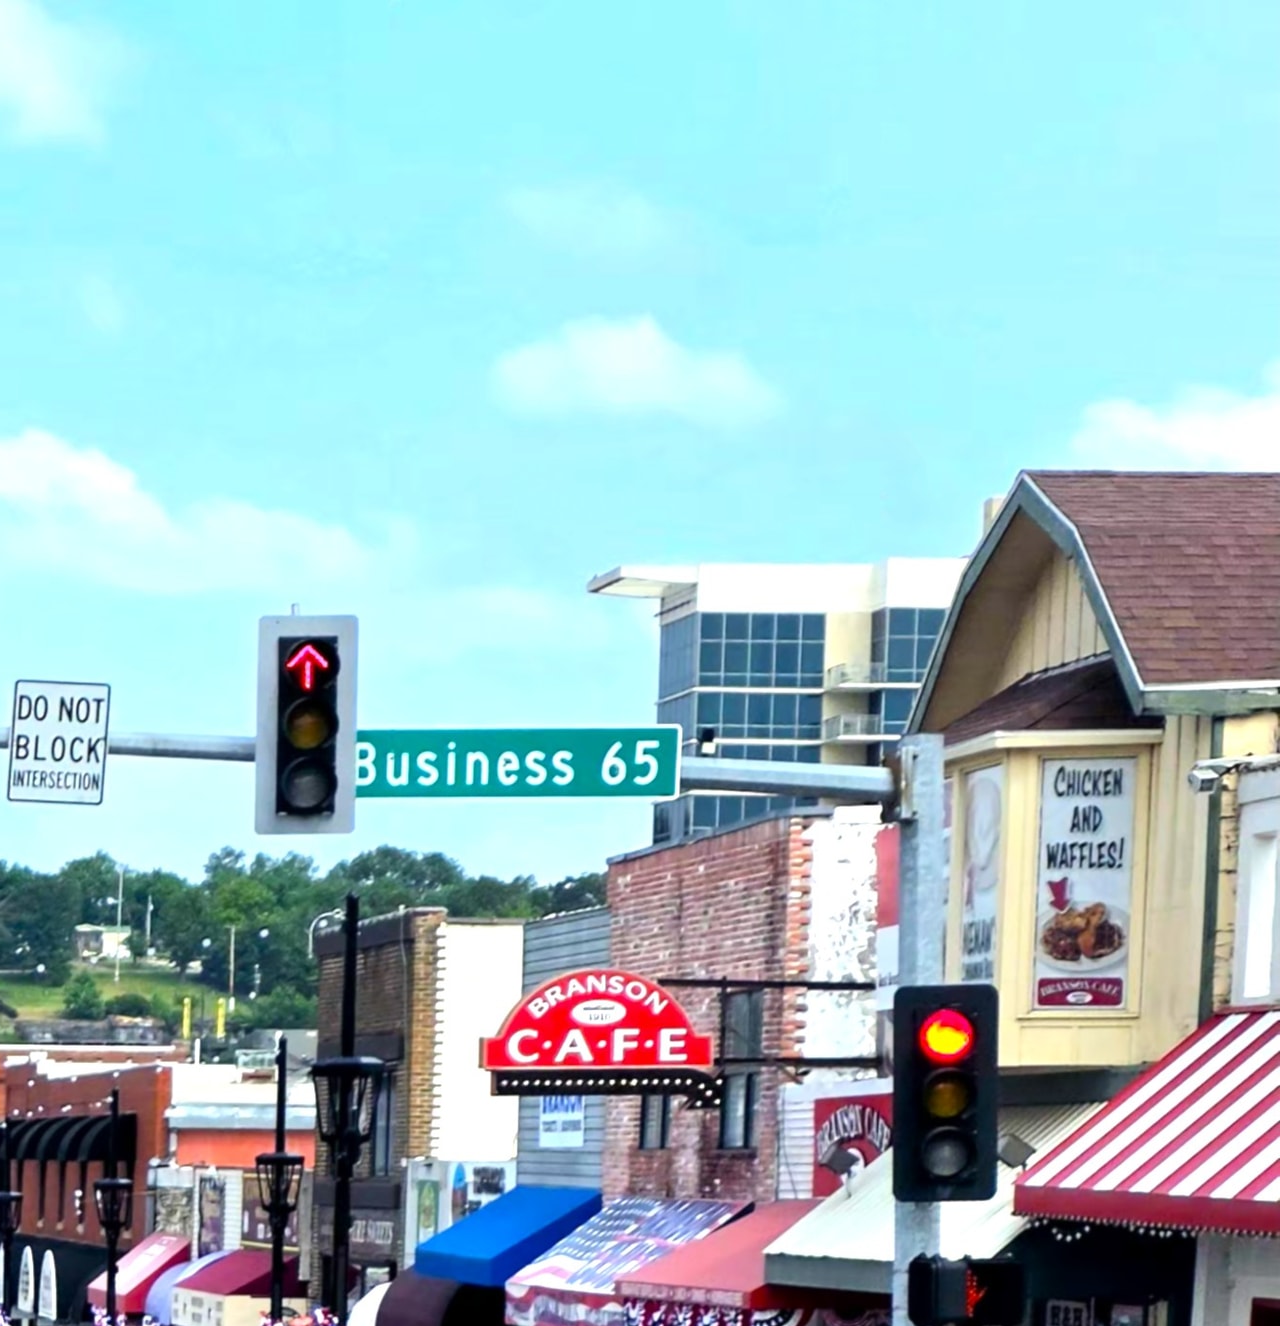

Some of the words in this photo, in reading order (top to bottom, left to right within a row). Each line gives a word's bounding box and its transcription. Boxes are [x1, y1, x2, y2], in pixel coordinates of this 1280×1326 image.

[18, 694, 48, 723] DO
[58, 697, 105, 725] NOT
[15, 734, 101, 763] BLOCK
[356, 742, 574, 787] Business
[601, 741, 659, 785] 65
[12, 769, 100, 792] INTERSECTION
[1054, 766, 1122, 797] CHICKEN
[1070, 805, 1102, 833] AND
[1046, 837, 1125, 870] WAFFLES!
[527, 974, 669, 1019] BRANSON
